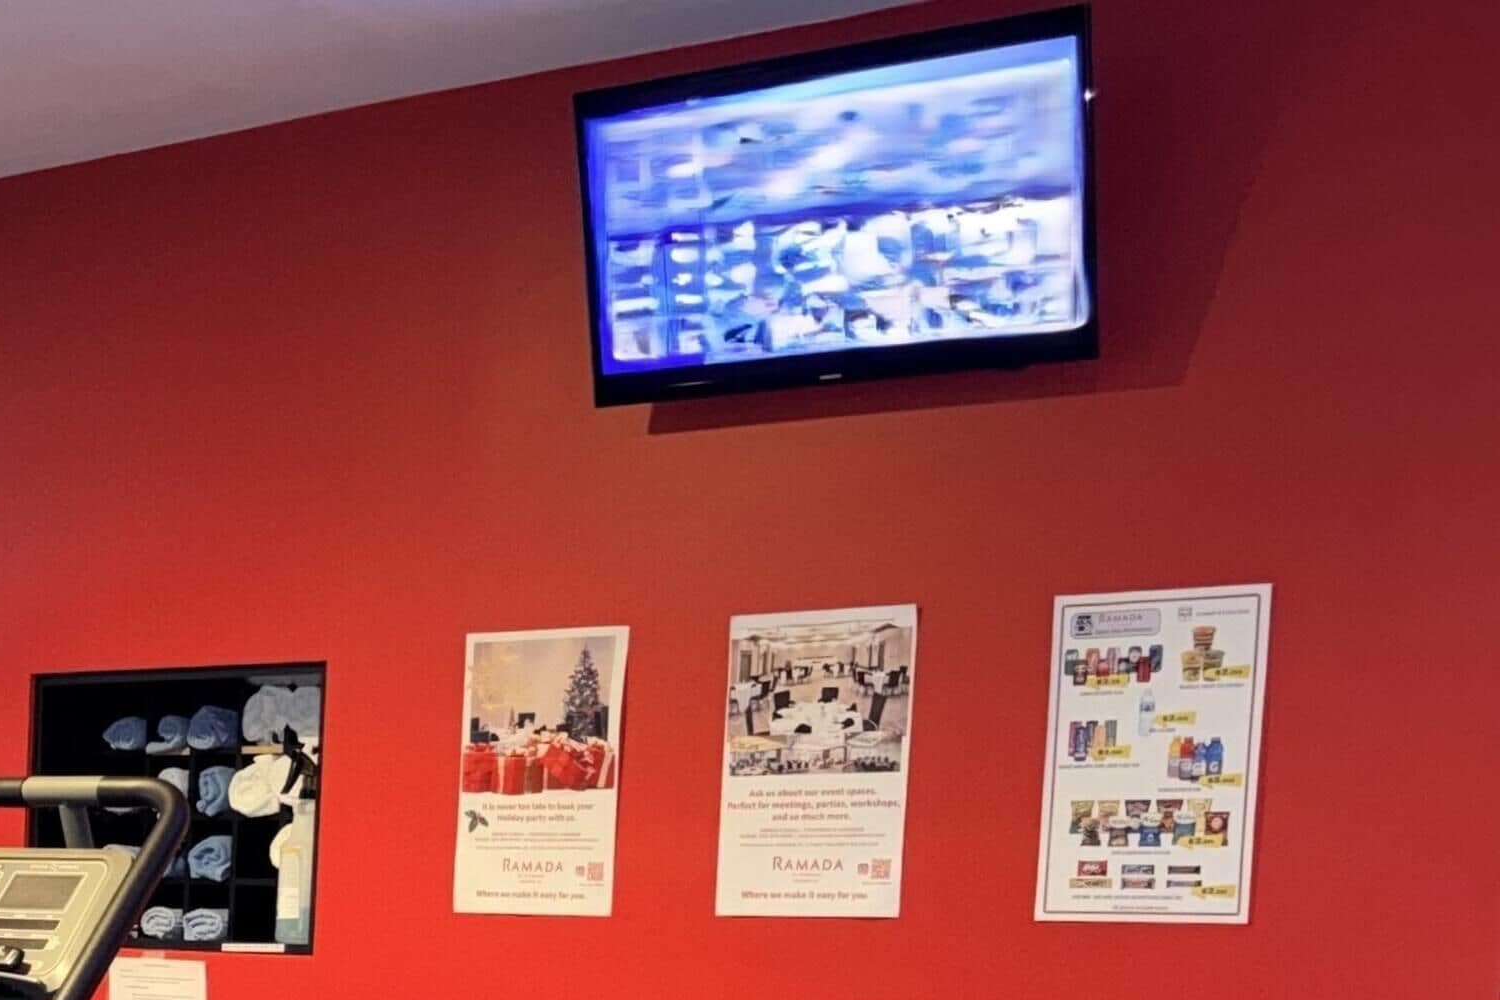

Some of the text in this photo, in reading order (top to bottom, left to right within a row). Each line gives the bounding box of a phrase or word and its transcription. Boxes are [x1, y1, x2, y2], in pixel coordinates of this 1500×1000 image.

[748, 789, 764, 797] Ask
[777, 789, 802, 797] about
[820, 788, 844, 796] event
[758, 800, 770, 809] for
[771, 812, 788, 821] and
[800, 812, 825, 821] much
[502, 857, 564, 873] RAMADA
[772, 855, 844, 872] RAMADA
